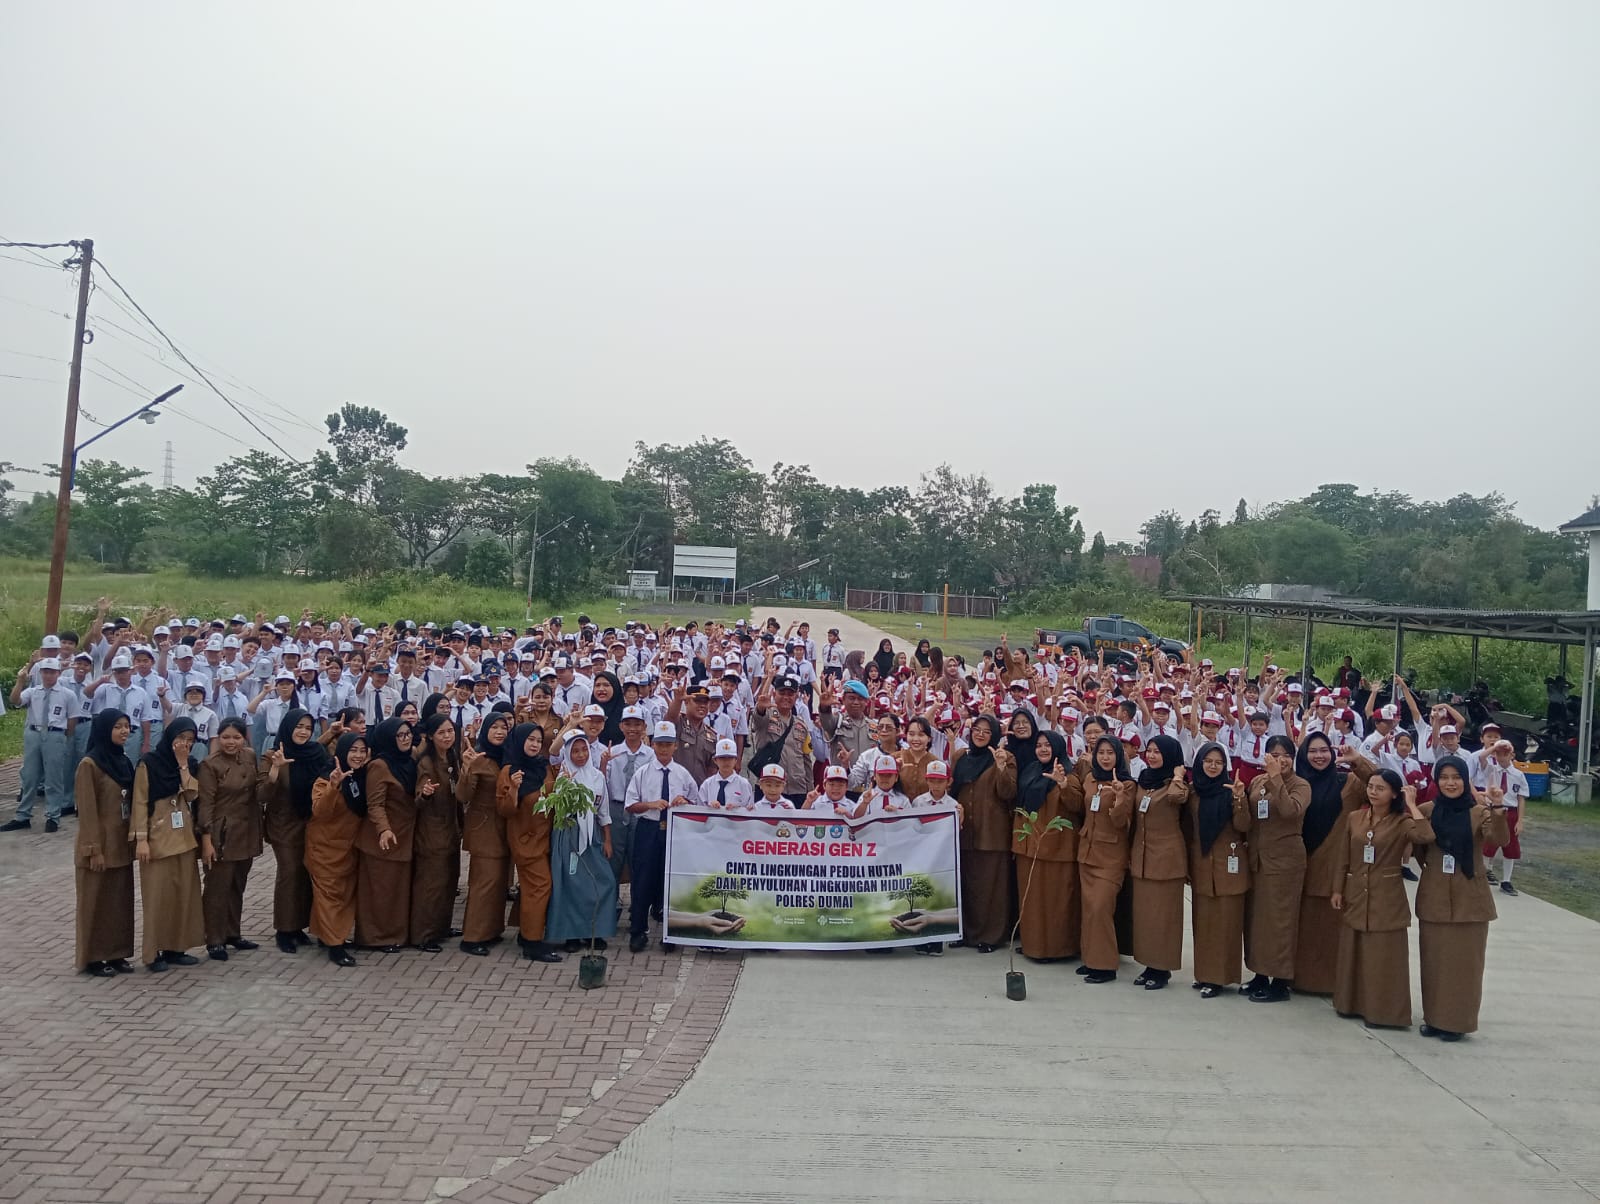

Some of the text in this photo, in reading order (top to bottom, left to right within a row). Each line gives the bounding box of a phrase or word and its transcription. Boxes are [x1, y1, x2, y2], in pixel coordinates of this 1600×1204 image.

[1095, 639, 1132, 649] POLISI
[742, 840, 877, 857] GENERASI GEN Z
[726, 862, 902, 877] CINTA LINGKUNGAN PEDULI HUTAN
[716, 877, 912, 892] DAN PENYULUHAN LINGKUNGAN HIDUP
[776, 895, 853, 908] POLRES DUMAI
